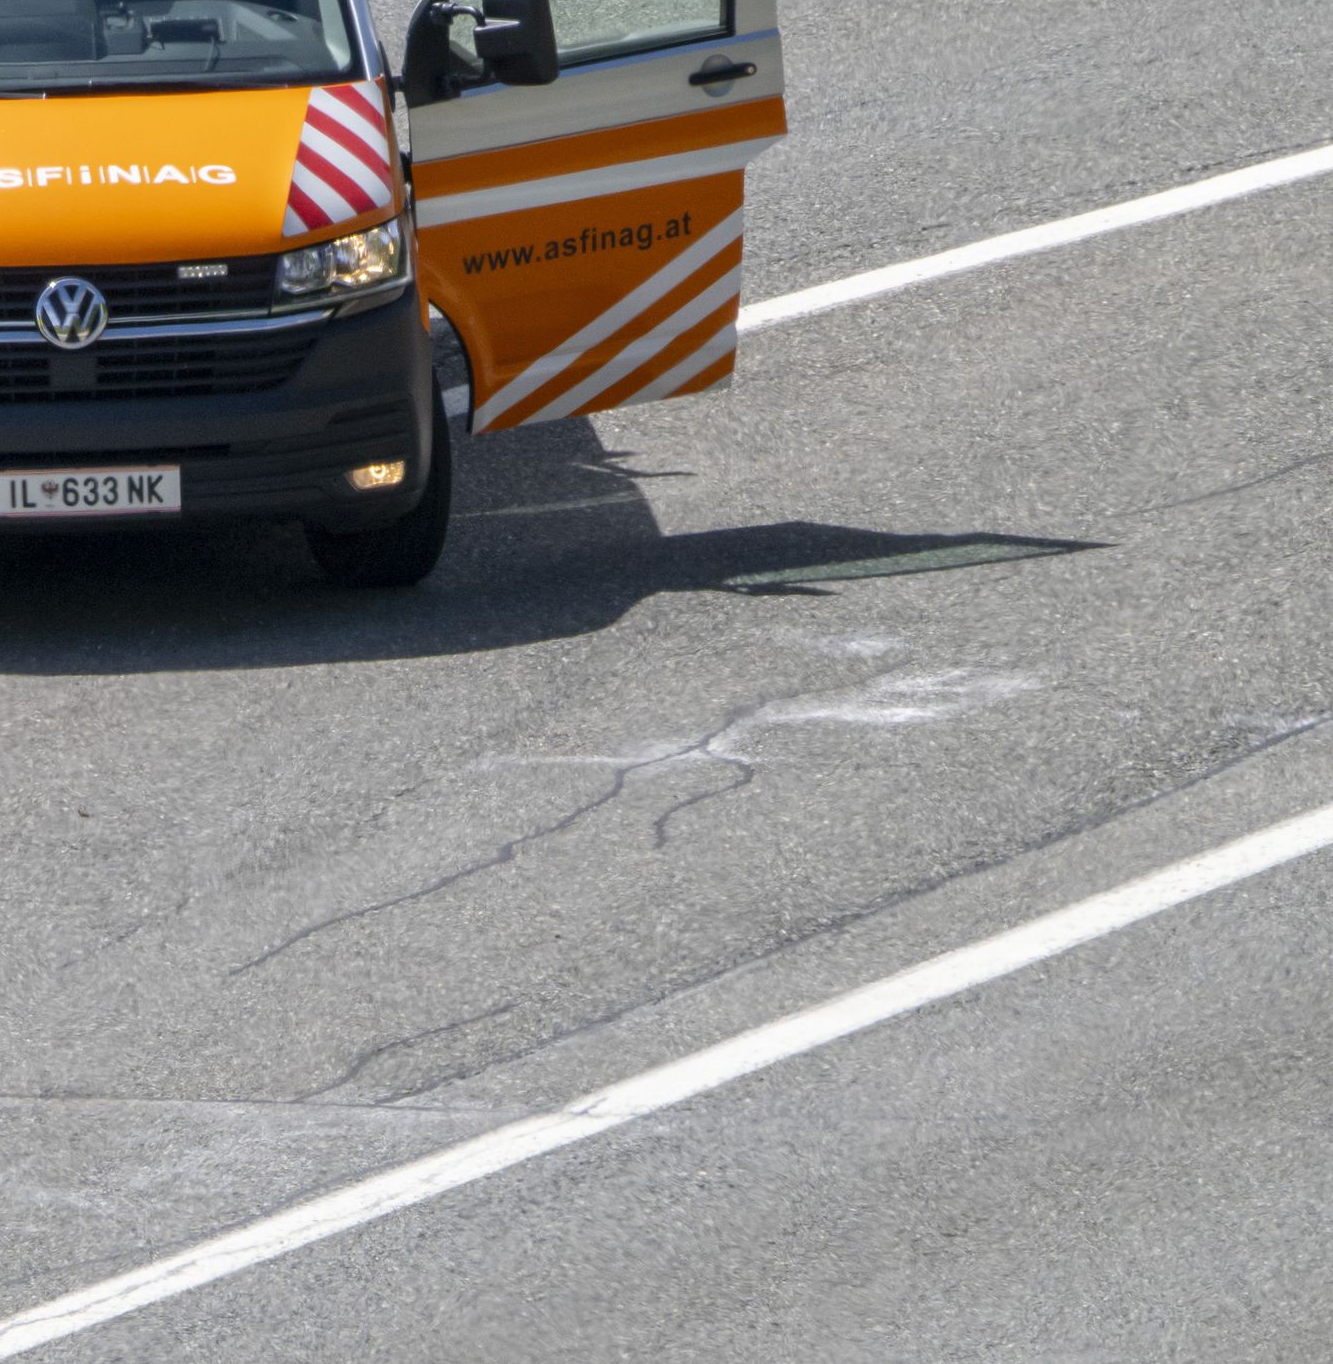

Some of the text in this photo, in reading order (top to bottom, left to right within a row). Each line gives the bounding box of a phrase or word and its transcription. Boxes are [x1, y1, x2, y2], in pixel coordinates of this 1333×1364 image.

[463, 212, 693, 276] www.asfinag.at
[10, 474, 165, 508] IL 633 NK
